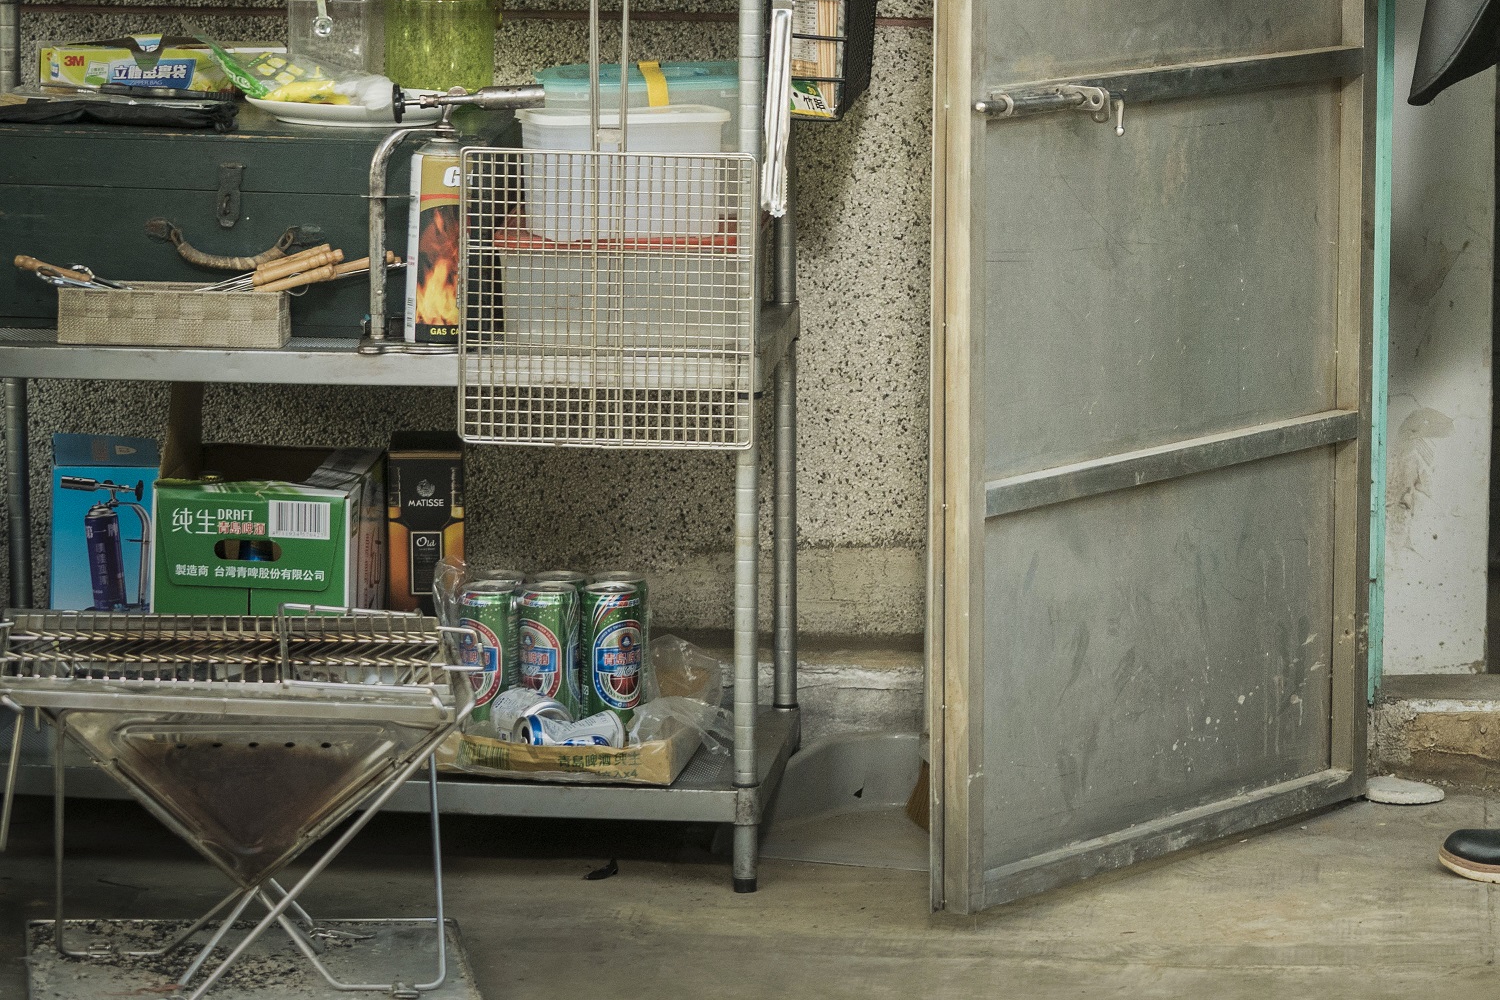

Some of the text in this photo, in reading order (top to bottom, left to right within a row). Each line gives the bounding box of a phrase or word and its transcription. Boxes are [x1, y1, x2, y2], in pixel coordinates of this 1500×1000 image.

[64, 55, 85, 67] 3M
[430, 327, 447, 336] GAS
[408, 498, 444, 507] MATISSE
[217, 509, 254, 520] DRAFT
[217, 521, 266, 536] 青島啤酒
[175, 564, 325, 582] 製造商 台灣青啤股份有限公司
